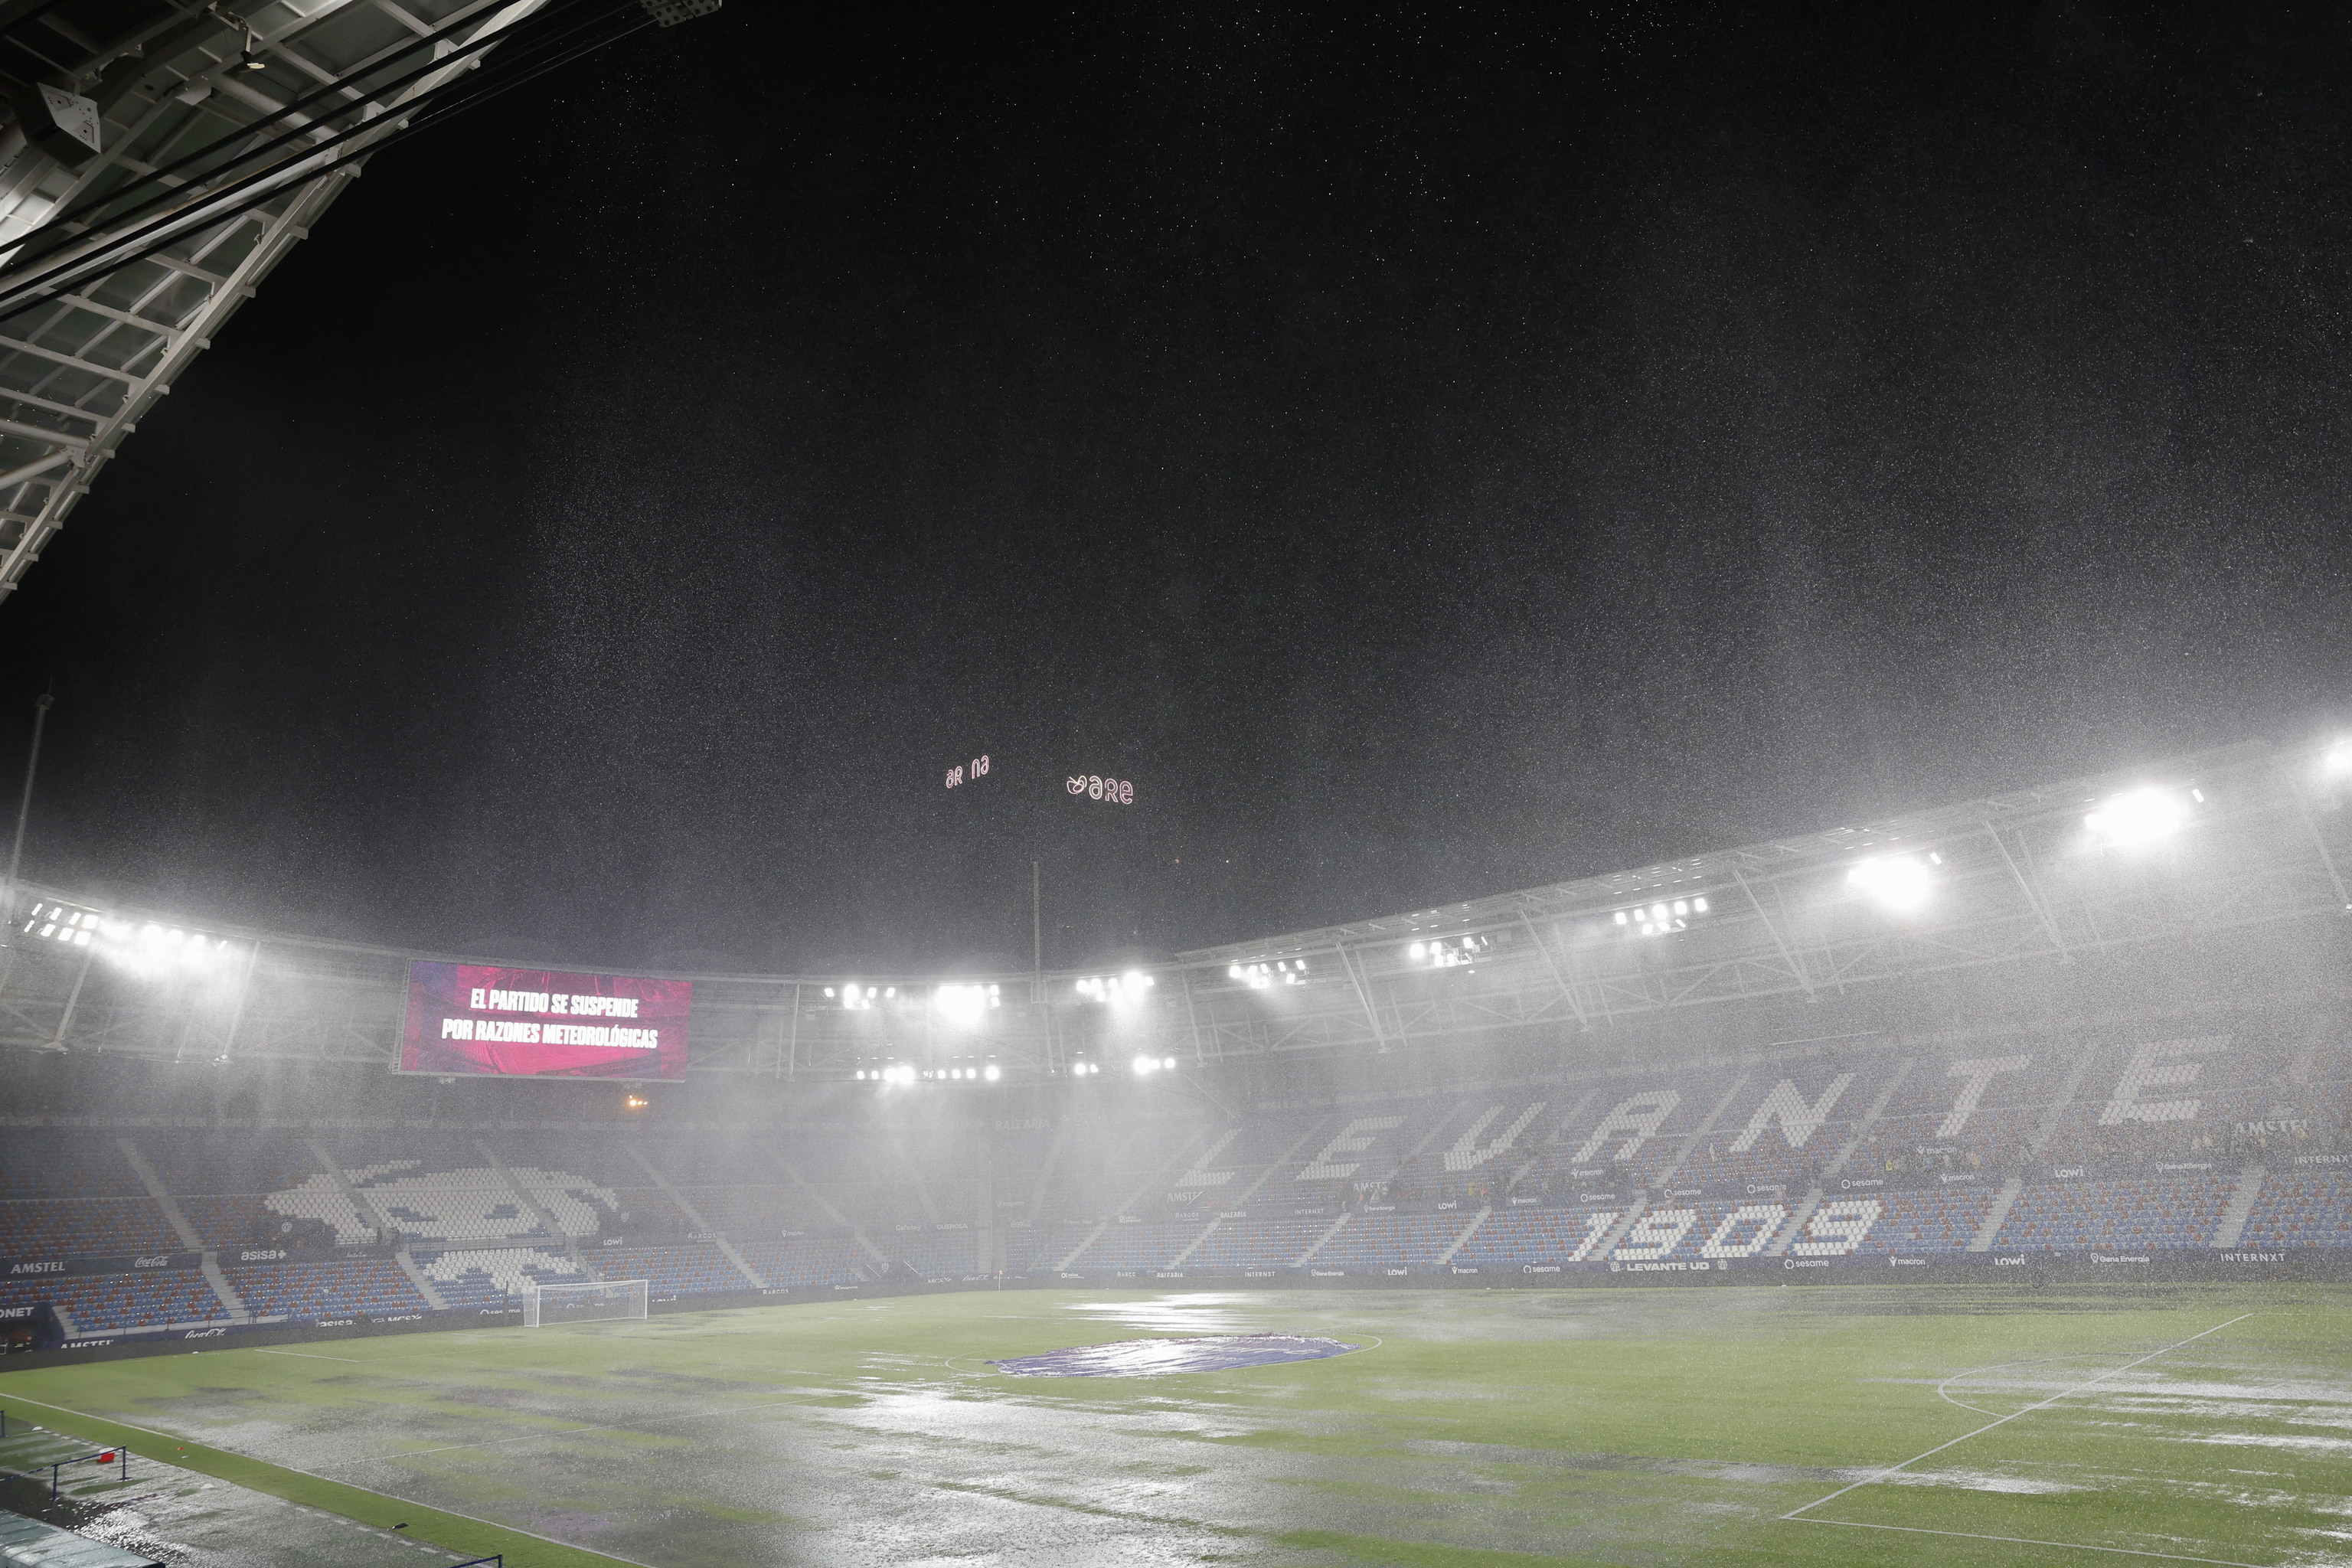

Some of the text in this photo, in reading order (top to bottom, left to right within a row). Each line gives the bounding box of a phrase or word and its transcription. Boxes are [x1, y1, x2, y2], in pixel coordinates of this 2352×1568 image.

[470, 988, 639, 1018] EL PARTIDO SE SUSPENDE
[441, 1018, 658, 1049] POR RAZONES METEOROLÓGICAS
[1851, 1178, 1883, 1187] sesame
[1568, 1200, 1883, 1263] 1909
[240, 1250, 276, 1261] asisa
[2220, 1253, 2285, 1262] INTERNXT
[11, 1262, 66, 1274] AMSTEL
[1627, 1262, 1710, 1272] LEVANTE UD
[1795, 1259, 1829, 1268] sesame
